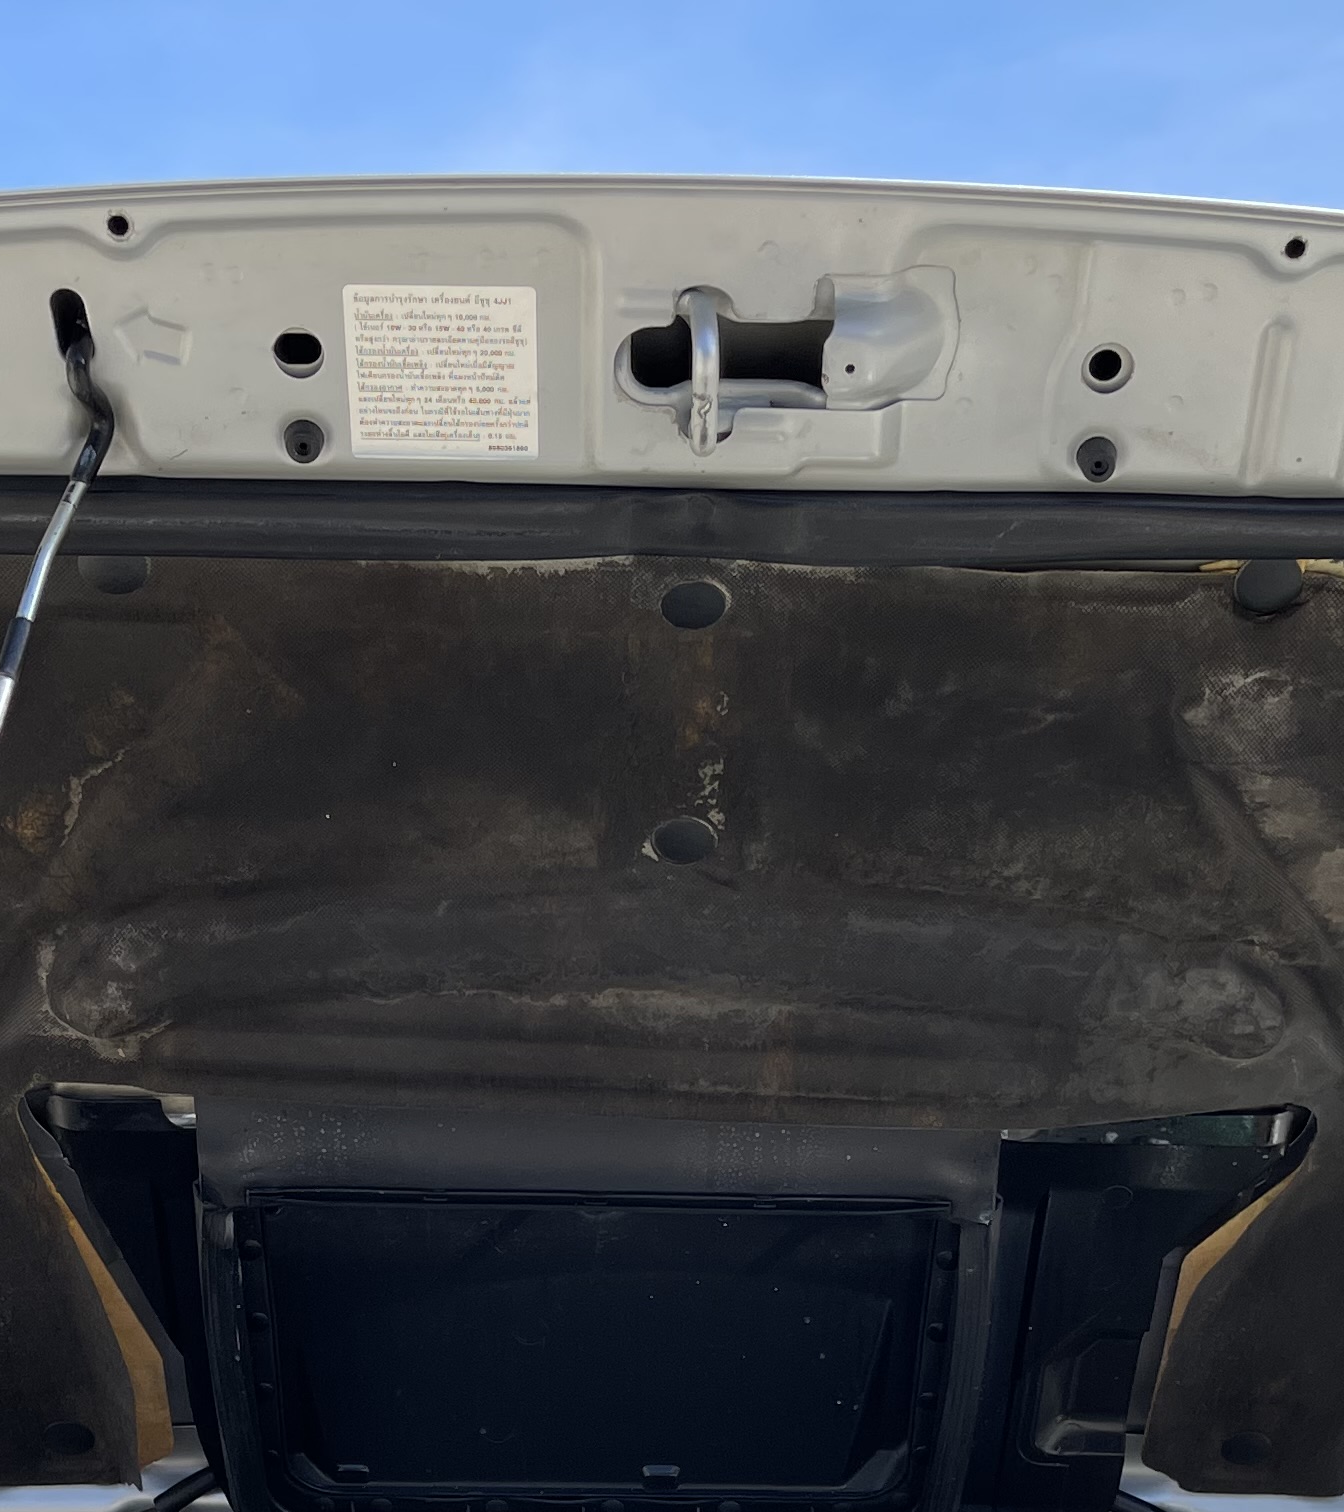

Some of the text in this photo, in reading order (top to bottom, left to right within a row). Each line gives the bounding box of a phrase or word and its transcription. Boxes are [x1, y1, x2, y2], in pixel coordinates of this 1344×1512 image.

[431, 292, 471, 305] เครื่องยนต์
[474, 294, 491, 308] อีซูซุ
